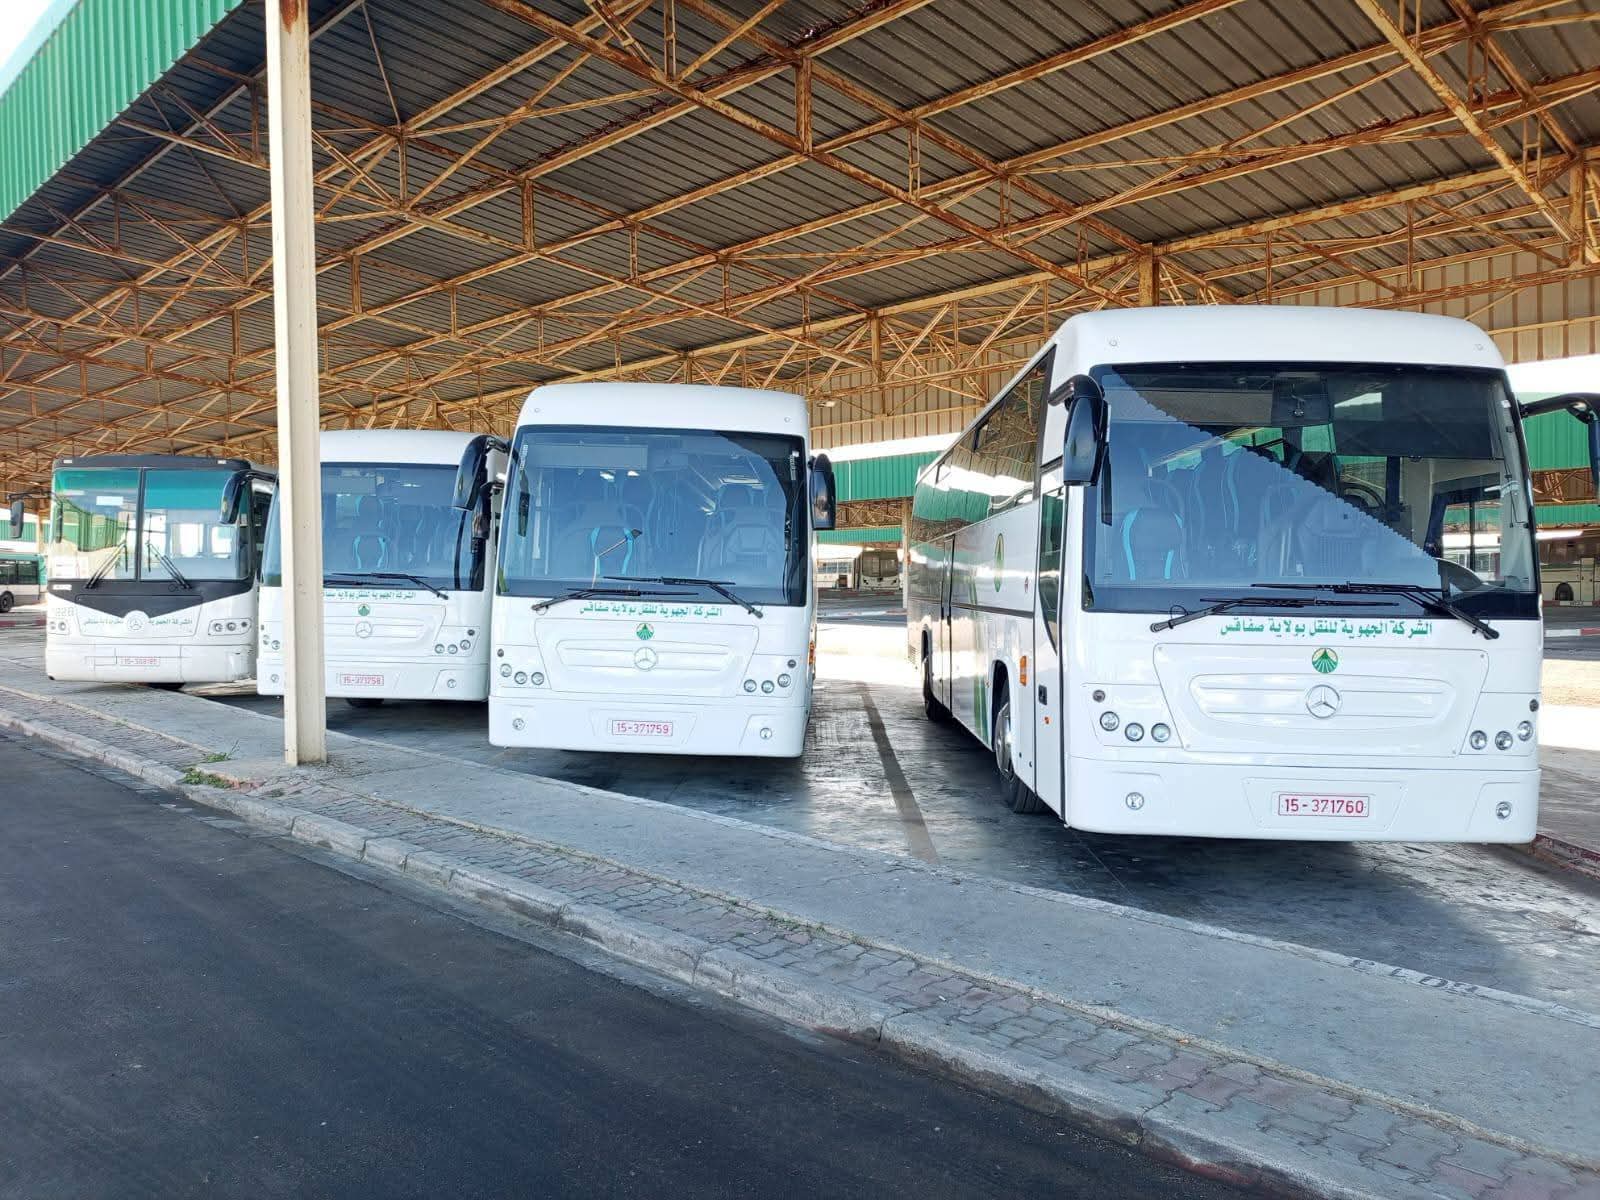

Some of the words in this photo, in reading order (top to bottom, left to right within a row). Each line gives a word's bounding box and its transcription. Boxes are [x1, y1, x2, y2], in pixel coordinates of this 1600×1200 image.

[693, 604, 722, 618] الشركة
[1220, 617, 1265, 636] صفاقس
[1269, 618, 1306, 637] بولاية
[1309, 618, 1338, 637] للنقل
[1341, 618, 1388, 639] الجهوية
[1389, 619, 1433, 639] الشركة
[617, 722, 669, 734] 15-371759
[1284, 798, 1364, 814] 15-371760
